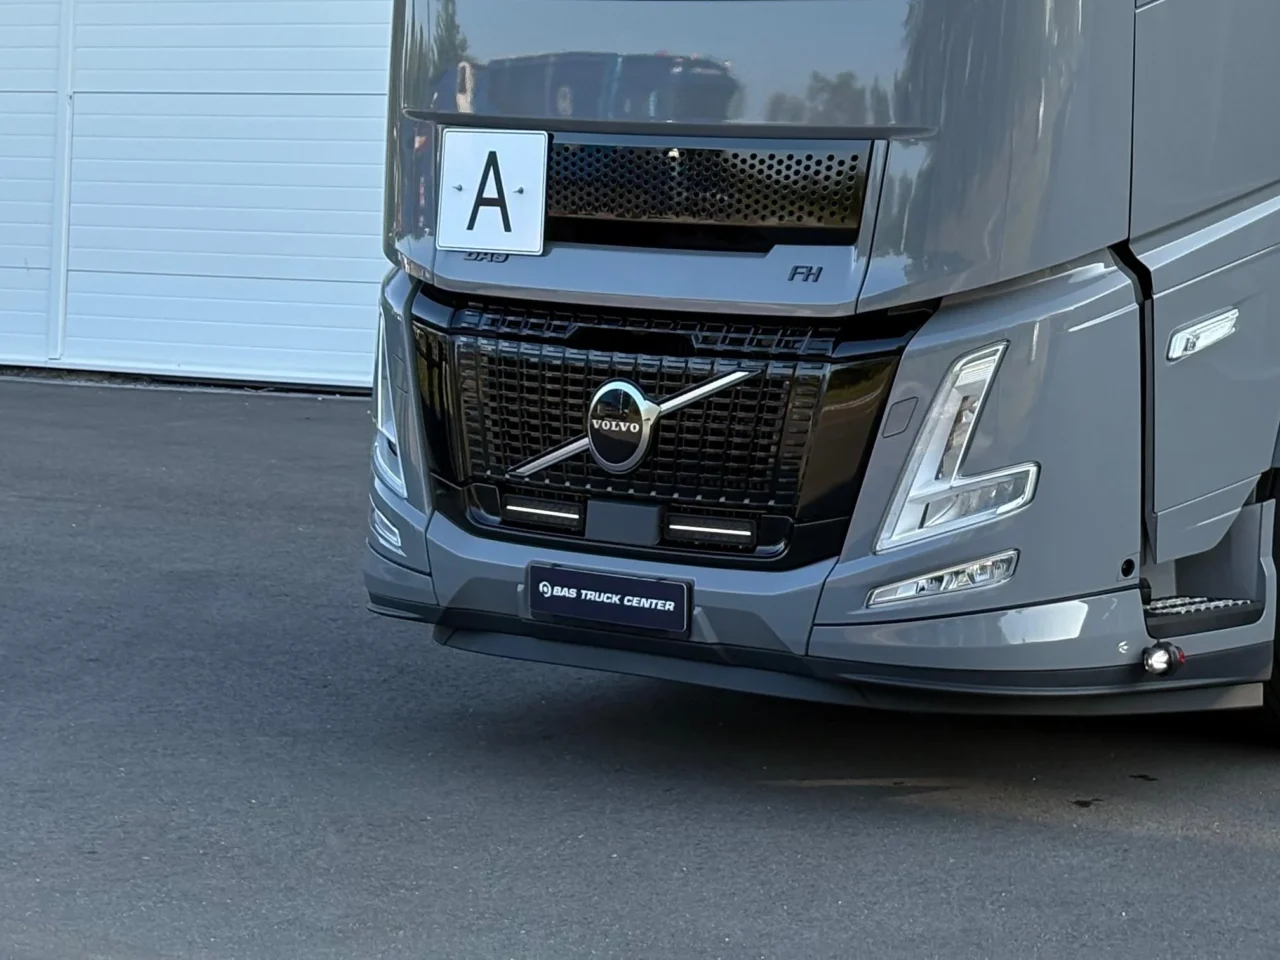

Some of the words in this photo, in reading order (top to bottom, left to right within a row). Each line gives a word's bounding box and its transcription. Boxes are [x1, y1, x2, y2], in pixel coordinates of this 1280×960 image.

[466, 149, 512, 233] A
[787, 264, 824, 283] FH
[591, 418, 641, 434] VOLVO
[552, 586, 577, 599] BAS
[580, 589, 621, 605] TRUCK
[623, 595, 676, 612] CENTER
